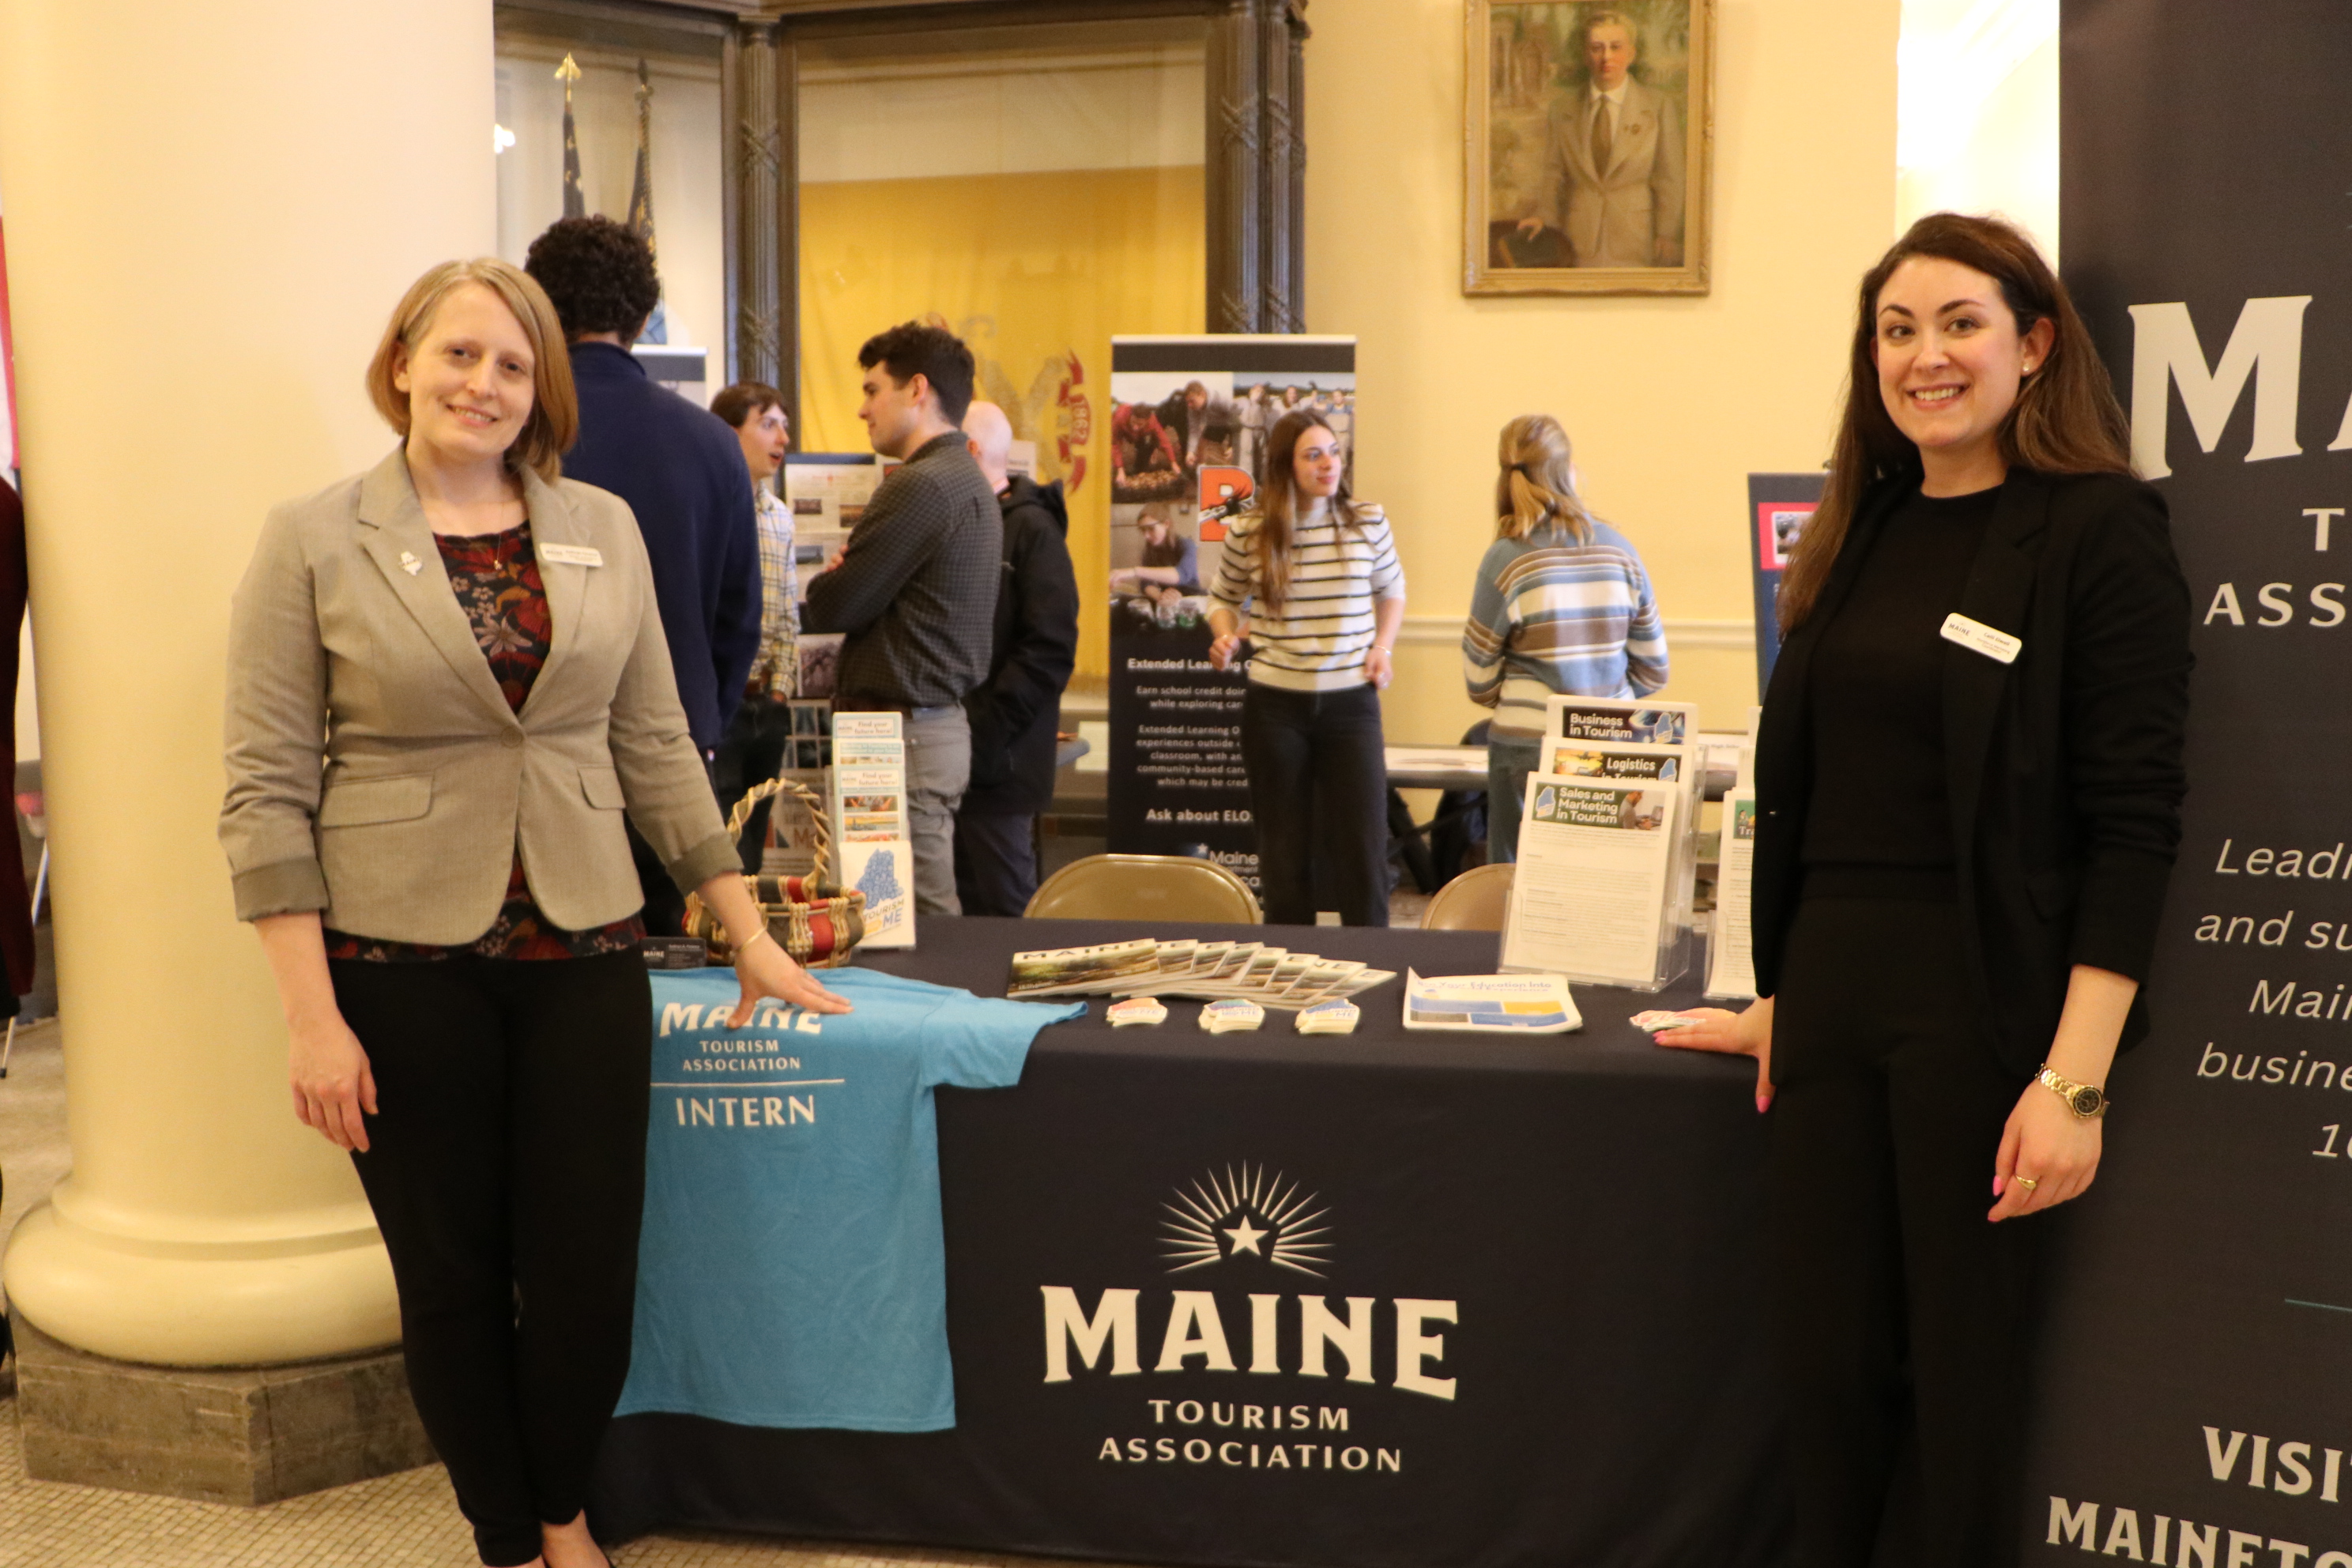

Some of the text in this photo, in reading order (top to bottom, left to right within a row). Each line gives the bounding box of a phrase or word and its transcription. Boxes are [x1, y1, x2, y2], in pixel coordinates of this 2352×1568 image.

[2128, 294, 2352, 482] M
[2203, 582, 2346, 628] ASS
[1127, 658, 1185, 669] Extended
[1188, 659, 1241, 672] Leang
[1136, 685, 1158, 695] Earn
[1161, 685, 1192, 695] school
[1194, 686, 1223, 695] credit
[1149, 699, 1176, 708] while
[1178, 699, 1223, 710] exploring
[1570, 713, 1623, 726] Business
[1138, 725, 1184, 734] Extended
[1187, 726, 1229, 736] Learning
[1570, 725, 1632, 739] in Tourism
[1136, 738, 1194, 748] experiences
[1197, 738, 1234, 748] outside
[1150, 751, 1202, 761] classroom,
[1206, 752, 1227, 760] with
[1607, 756, 1656, 771] Logistics
[1136, 764, 1223, 774] community-based
[1157, 777, 1185, 786] which
[1189, 778, 1208, 788] may
[1211, 778, 1223, 786] be
[1559, 786, 1615, 801] Sales and
[1558, 798, 1619, 815] Marketing
[1146, 808, 1253, 822] Ask about ELO
[1556, 809, 1618, 824] in Tourism
[1209, 850, 1259, 865] Maine
[883, 907, 903, 928] ME
[2194, 910, 2294, 946] and
[699, 1039, 779, 1053] TOURISM
[682, 1057, 801, 1072] ASSOCIATION
[676, 1095, 815, 1126] INTERN
[2312, 1124, 2352, 1159] 1
[1039, 1285, 1458, 1400] MAINE
[1148, 1399, 1349, 1431] TOURISM
[1099, 1437, 1401, 1472] ASSOCIATION
[2202, 1425, 2352, 1502] VISI
